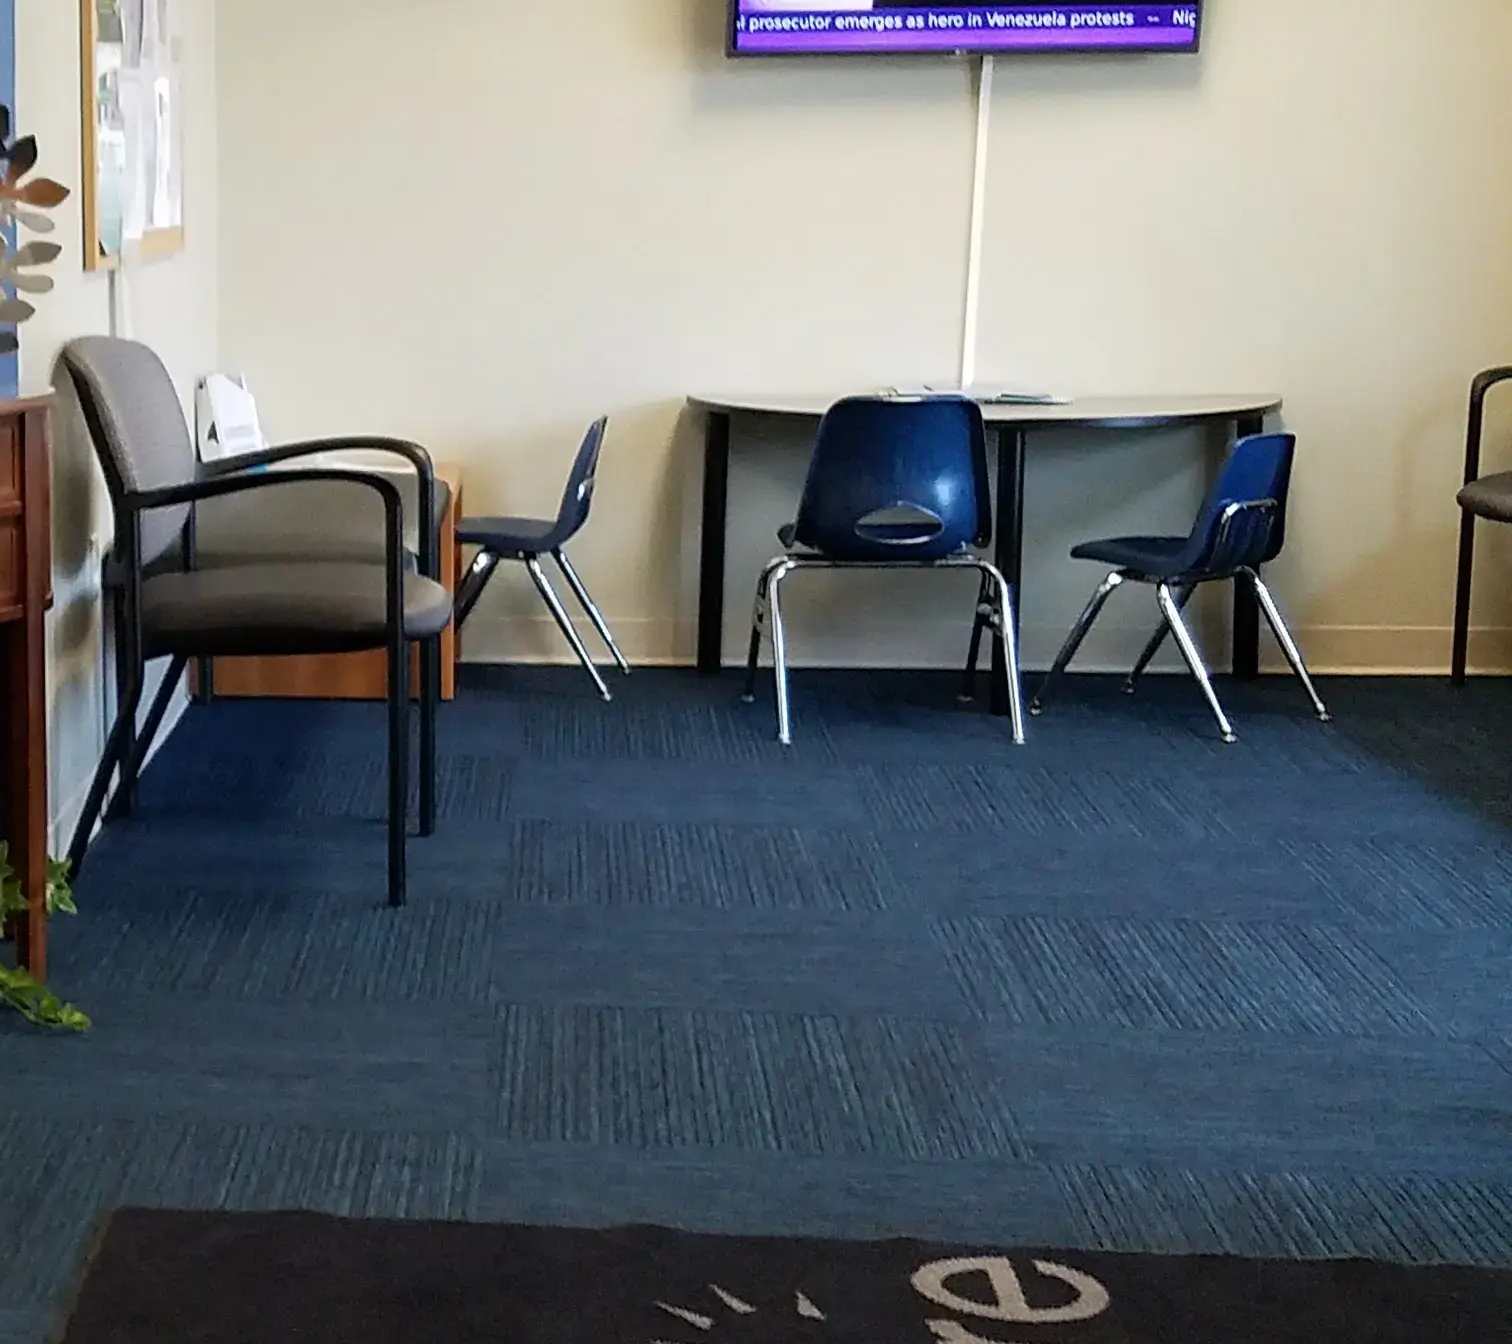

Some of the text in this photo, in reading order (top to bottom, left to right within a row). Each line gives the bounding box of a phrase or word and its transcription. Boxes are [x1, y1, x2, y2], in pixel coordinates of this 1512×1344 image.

[749, 14, 832, 33] prosecutor
[834, 13, 903, 32] emerges
[906, 14, 925, 30] as
[928, 12, 964, 28] hero
[968, 10, 983, 28] in
[987, 10, 1067, 28] Venezuela
[1070, 9, 1135, 28] protests
